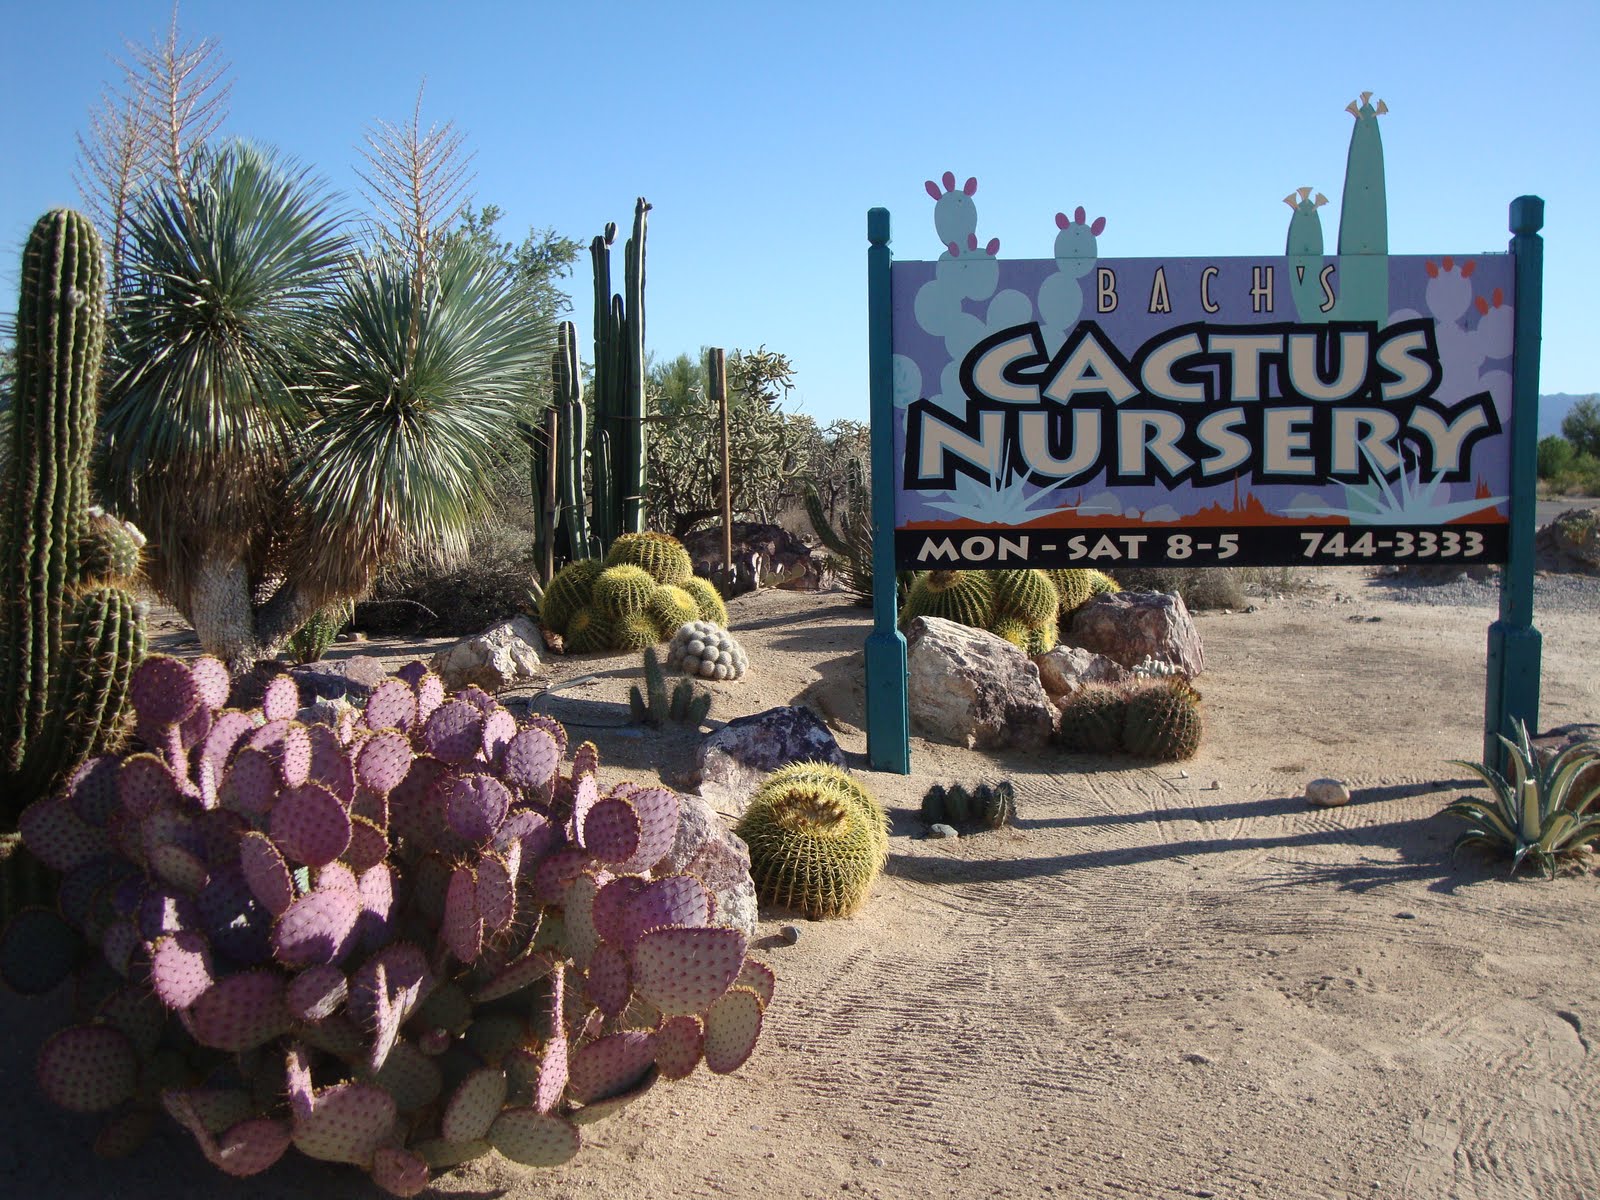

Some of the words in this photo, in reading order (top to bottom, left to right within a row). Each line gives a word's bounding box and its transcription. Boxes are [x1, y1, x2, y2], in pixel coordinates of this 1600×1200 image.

[1097, 264, 1336, 313] BACH'S
[973, 331, 1433, 405] CACTUS
[919, 404, 1490, 479] NURSERY
[917, 535, 1029, 562] MON
[1067, 535, 1148, 560] SAT
[1166, 533, 1239, 560] 8-5
[1300, 531, 1484, 558] 744-3333
